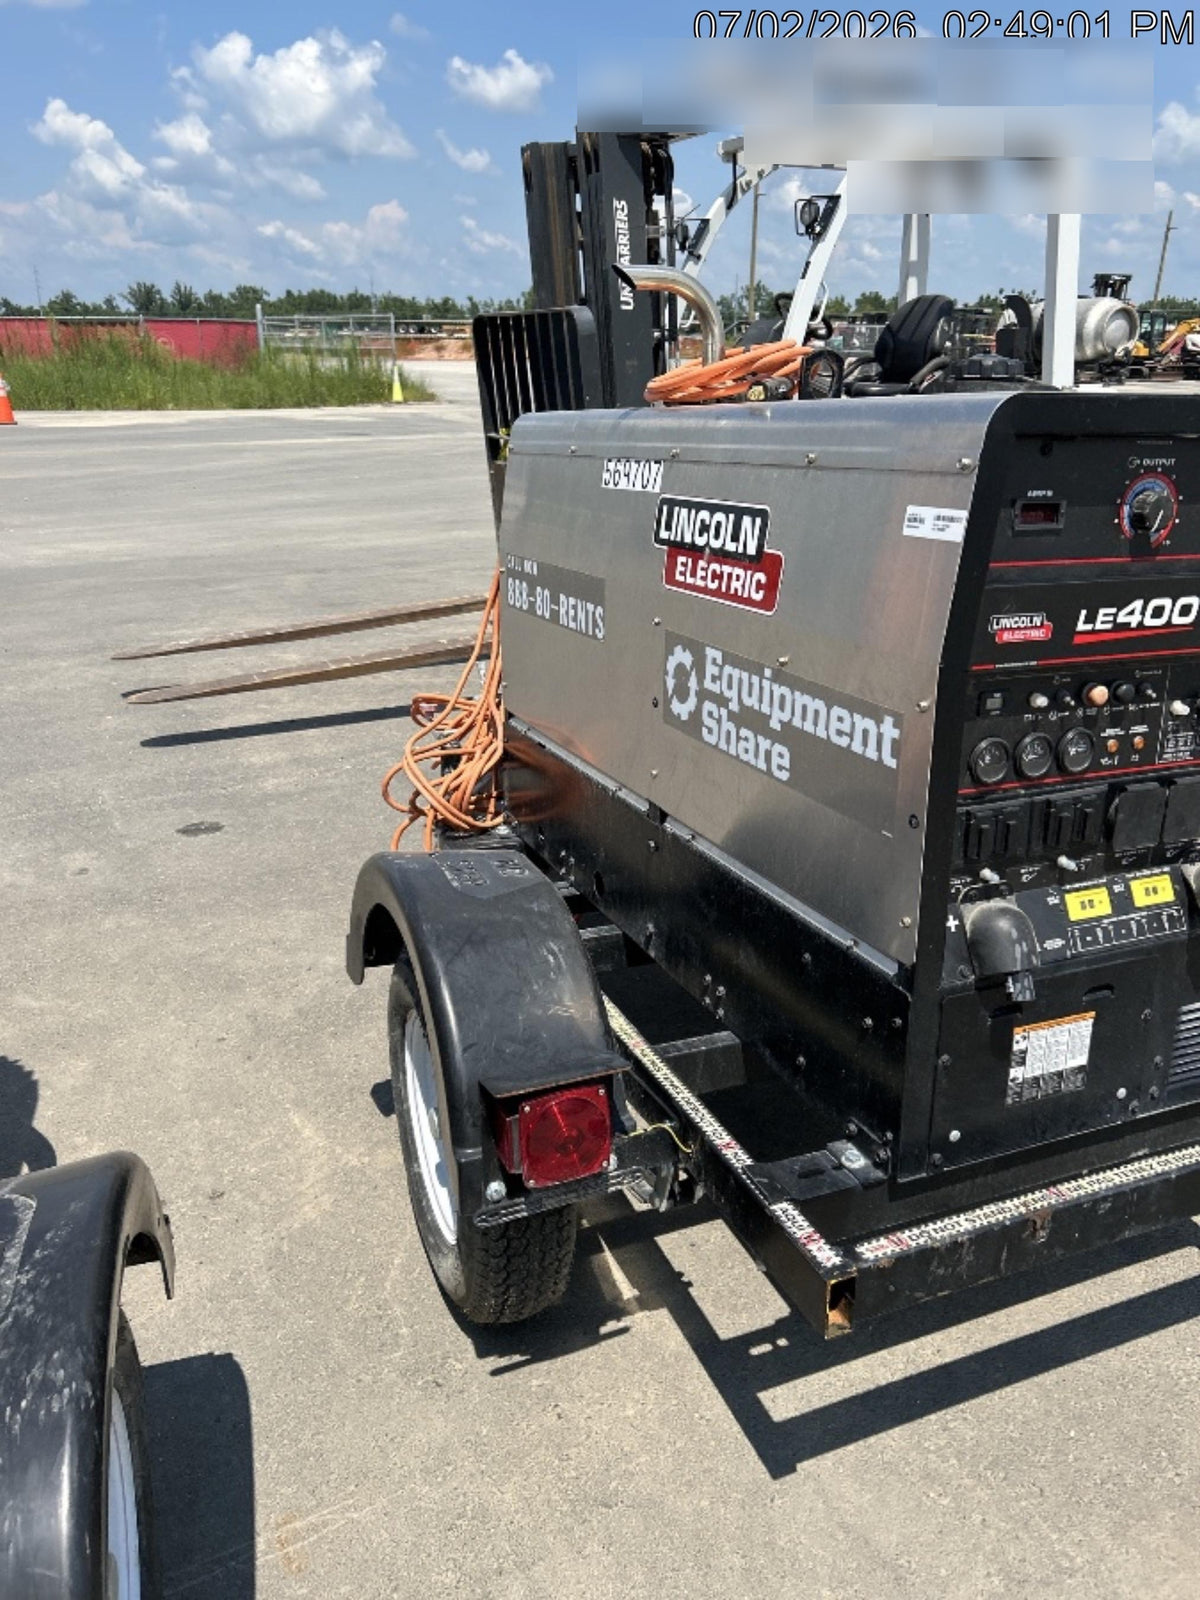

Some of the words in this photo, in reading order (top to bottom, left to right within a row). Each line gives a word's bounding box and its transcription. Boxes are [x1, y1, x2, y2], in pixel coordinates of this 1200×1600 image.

[1143, 458, 1176, 467] OUTPUT
[659, 504, 762, 556] LINCOLN
[675, 555, 767, 601] ELECTRIC
[507, 577, 604, 640] 888-80-RENTS
[993, 616, 1042, 630] LINCOLN
[1075, 595, 1200, 632] LE400
[703, 646, 900, 769] Equipment
[701, 699, 791, 781] Share
